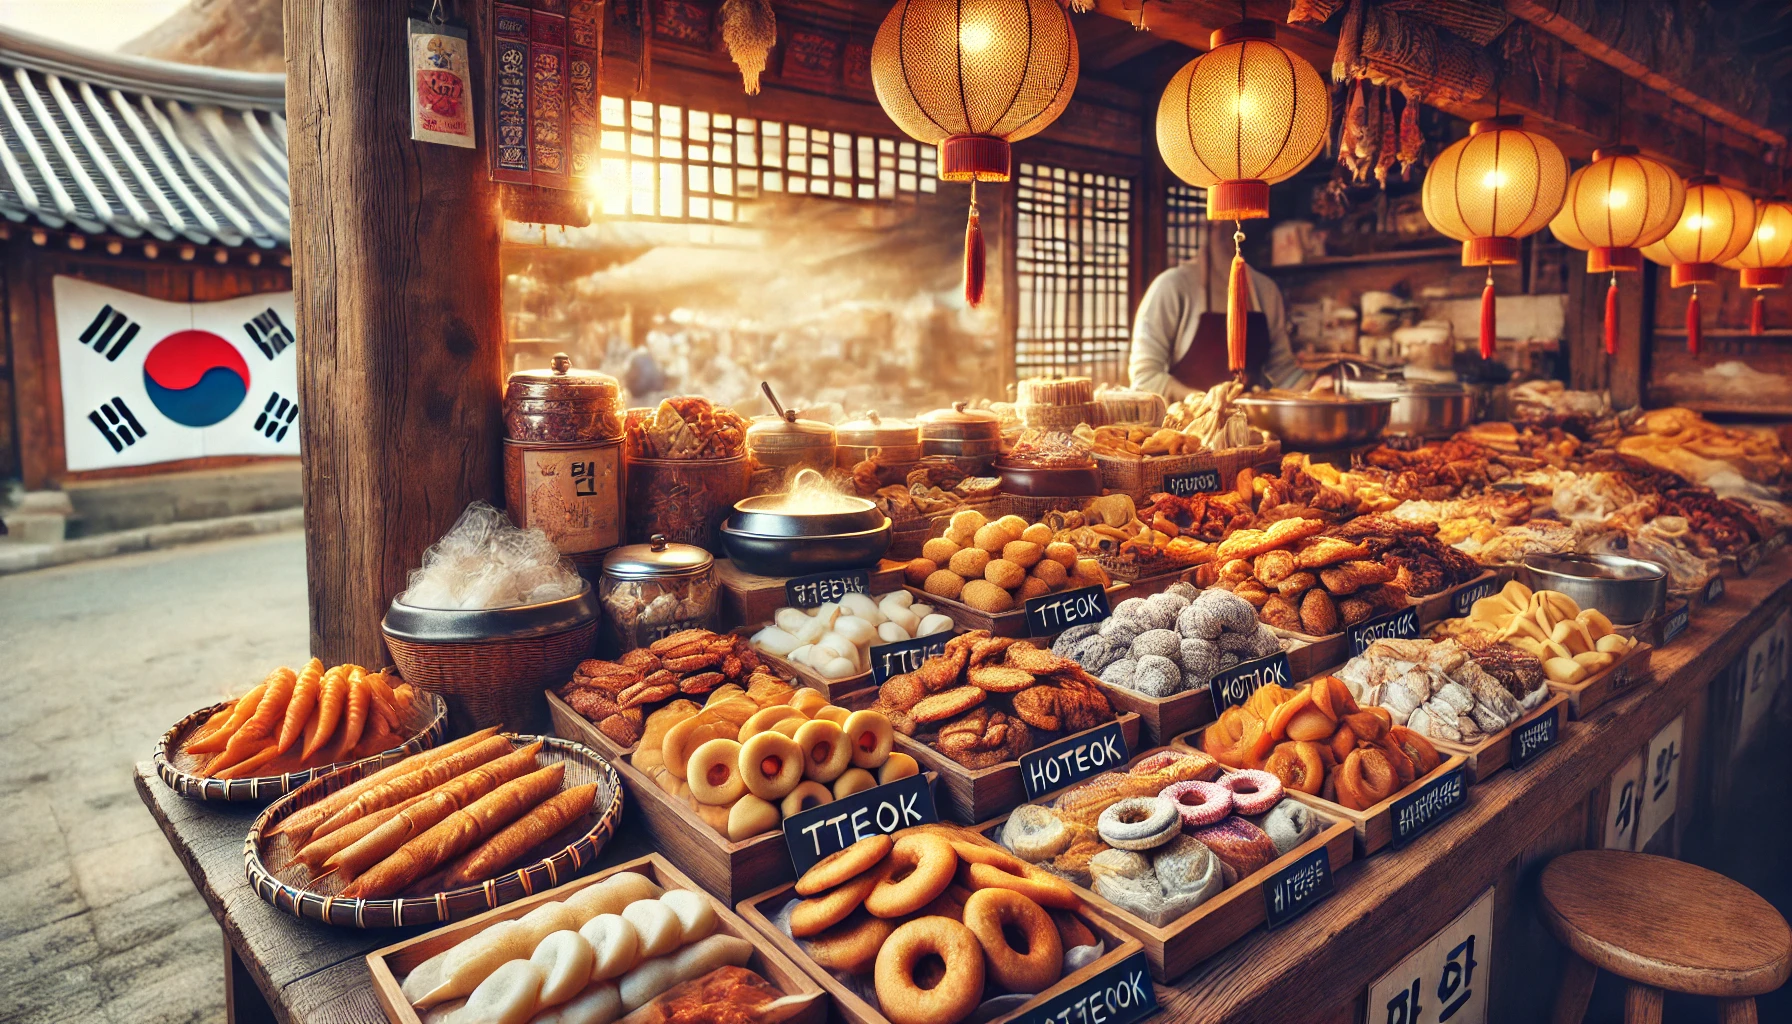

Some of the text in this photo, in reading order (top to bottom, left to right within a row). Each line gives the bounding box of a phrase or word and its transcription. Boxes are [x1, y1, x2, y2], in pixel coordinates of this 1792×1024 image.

[1034, 594, 1102, 628] TTEOK
[1030, 734, 1122, 793] HOTEOK
[802, 792, 922, 856] TTEOK
